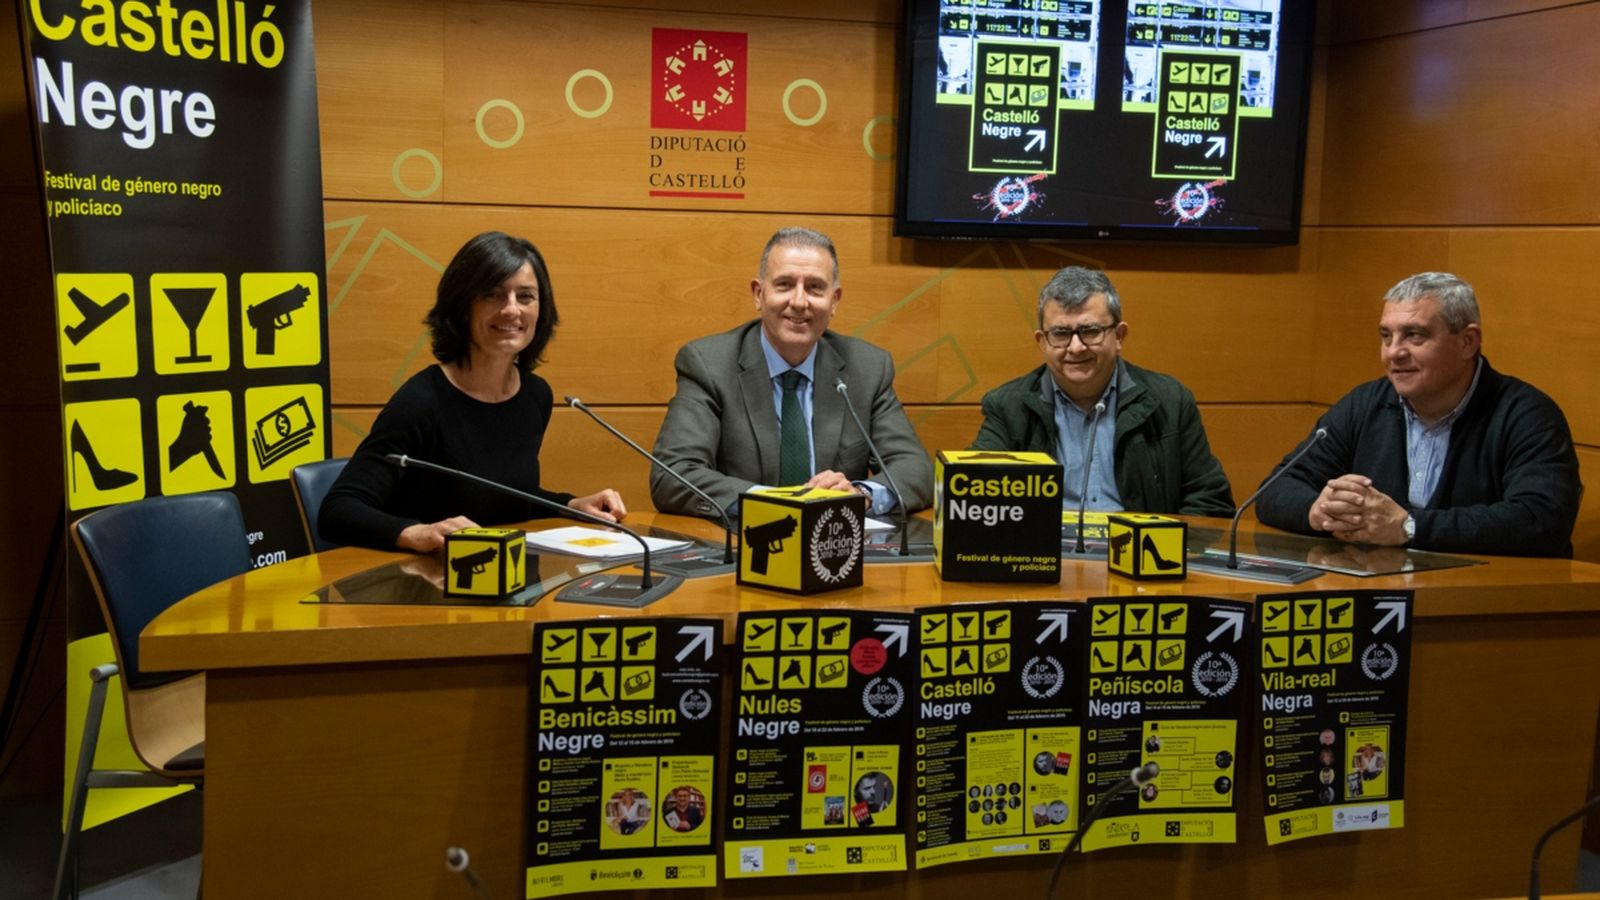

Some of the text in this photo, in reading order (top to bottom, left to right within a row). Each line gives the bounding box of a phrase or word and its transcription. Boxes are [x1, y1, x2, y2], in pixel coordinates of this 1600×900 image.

[30, 0, 285, 68] Castelló
[36, 57, 216, 149] Negre
[982, 108, 1040, 124] Castelló
[1166, 116, 1220, 131] Castelló
[982, 123, 1022, 139] Negre
[1165, 130, 1203, 146] Negre
[650, 135, 746, 152] DIPUTACIÓ
[650, 154, 745, 170] D E
[44, 171, 222, 199] Festival de género negro
[650, 172, 746, 188] CASTELLÓ
[55, 200, 122, 216] policíaco
[950, 473, 1058, 497] Castelló
[950, 500, 1024, 526] Negre
[818, 536, 853, 551] edición
[956, 553, 988, 562] Festival
[1002, 556, 1031, 564] género
[1012, 564, 1018, 572] y
[1028, 672, 1058, 680] edición
[1200, 668, 1230, 678] edición
[1261, 668, 1336, 691] Vila-real
[920, 677, 996, 700] Castelló
[1089, 675, 1184, 697] Peñíscola
[740, 694, 802, 715] Nules
[921, 702, 972, 720] Negre
[1088, 699, 1141, 719] Negra
[1262, 694, 1313, 713] Negra
[539, 705, 676, 730] Benicàssim
[738, 718, 800, 740] Negre
[538, 732, 604, 754] Negre
